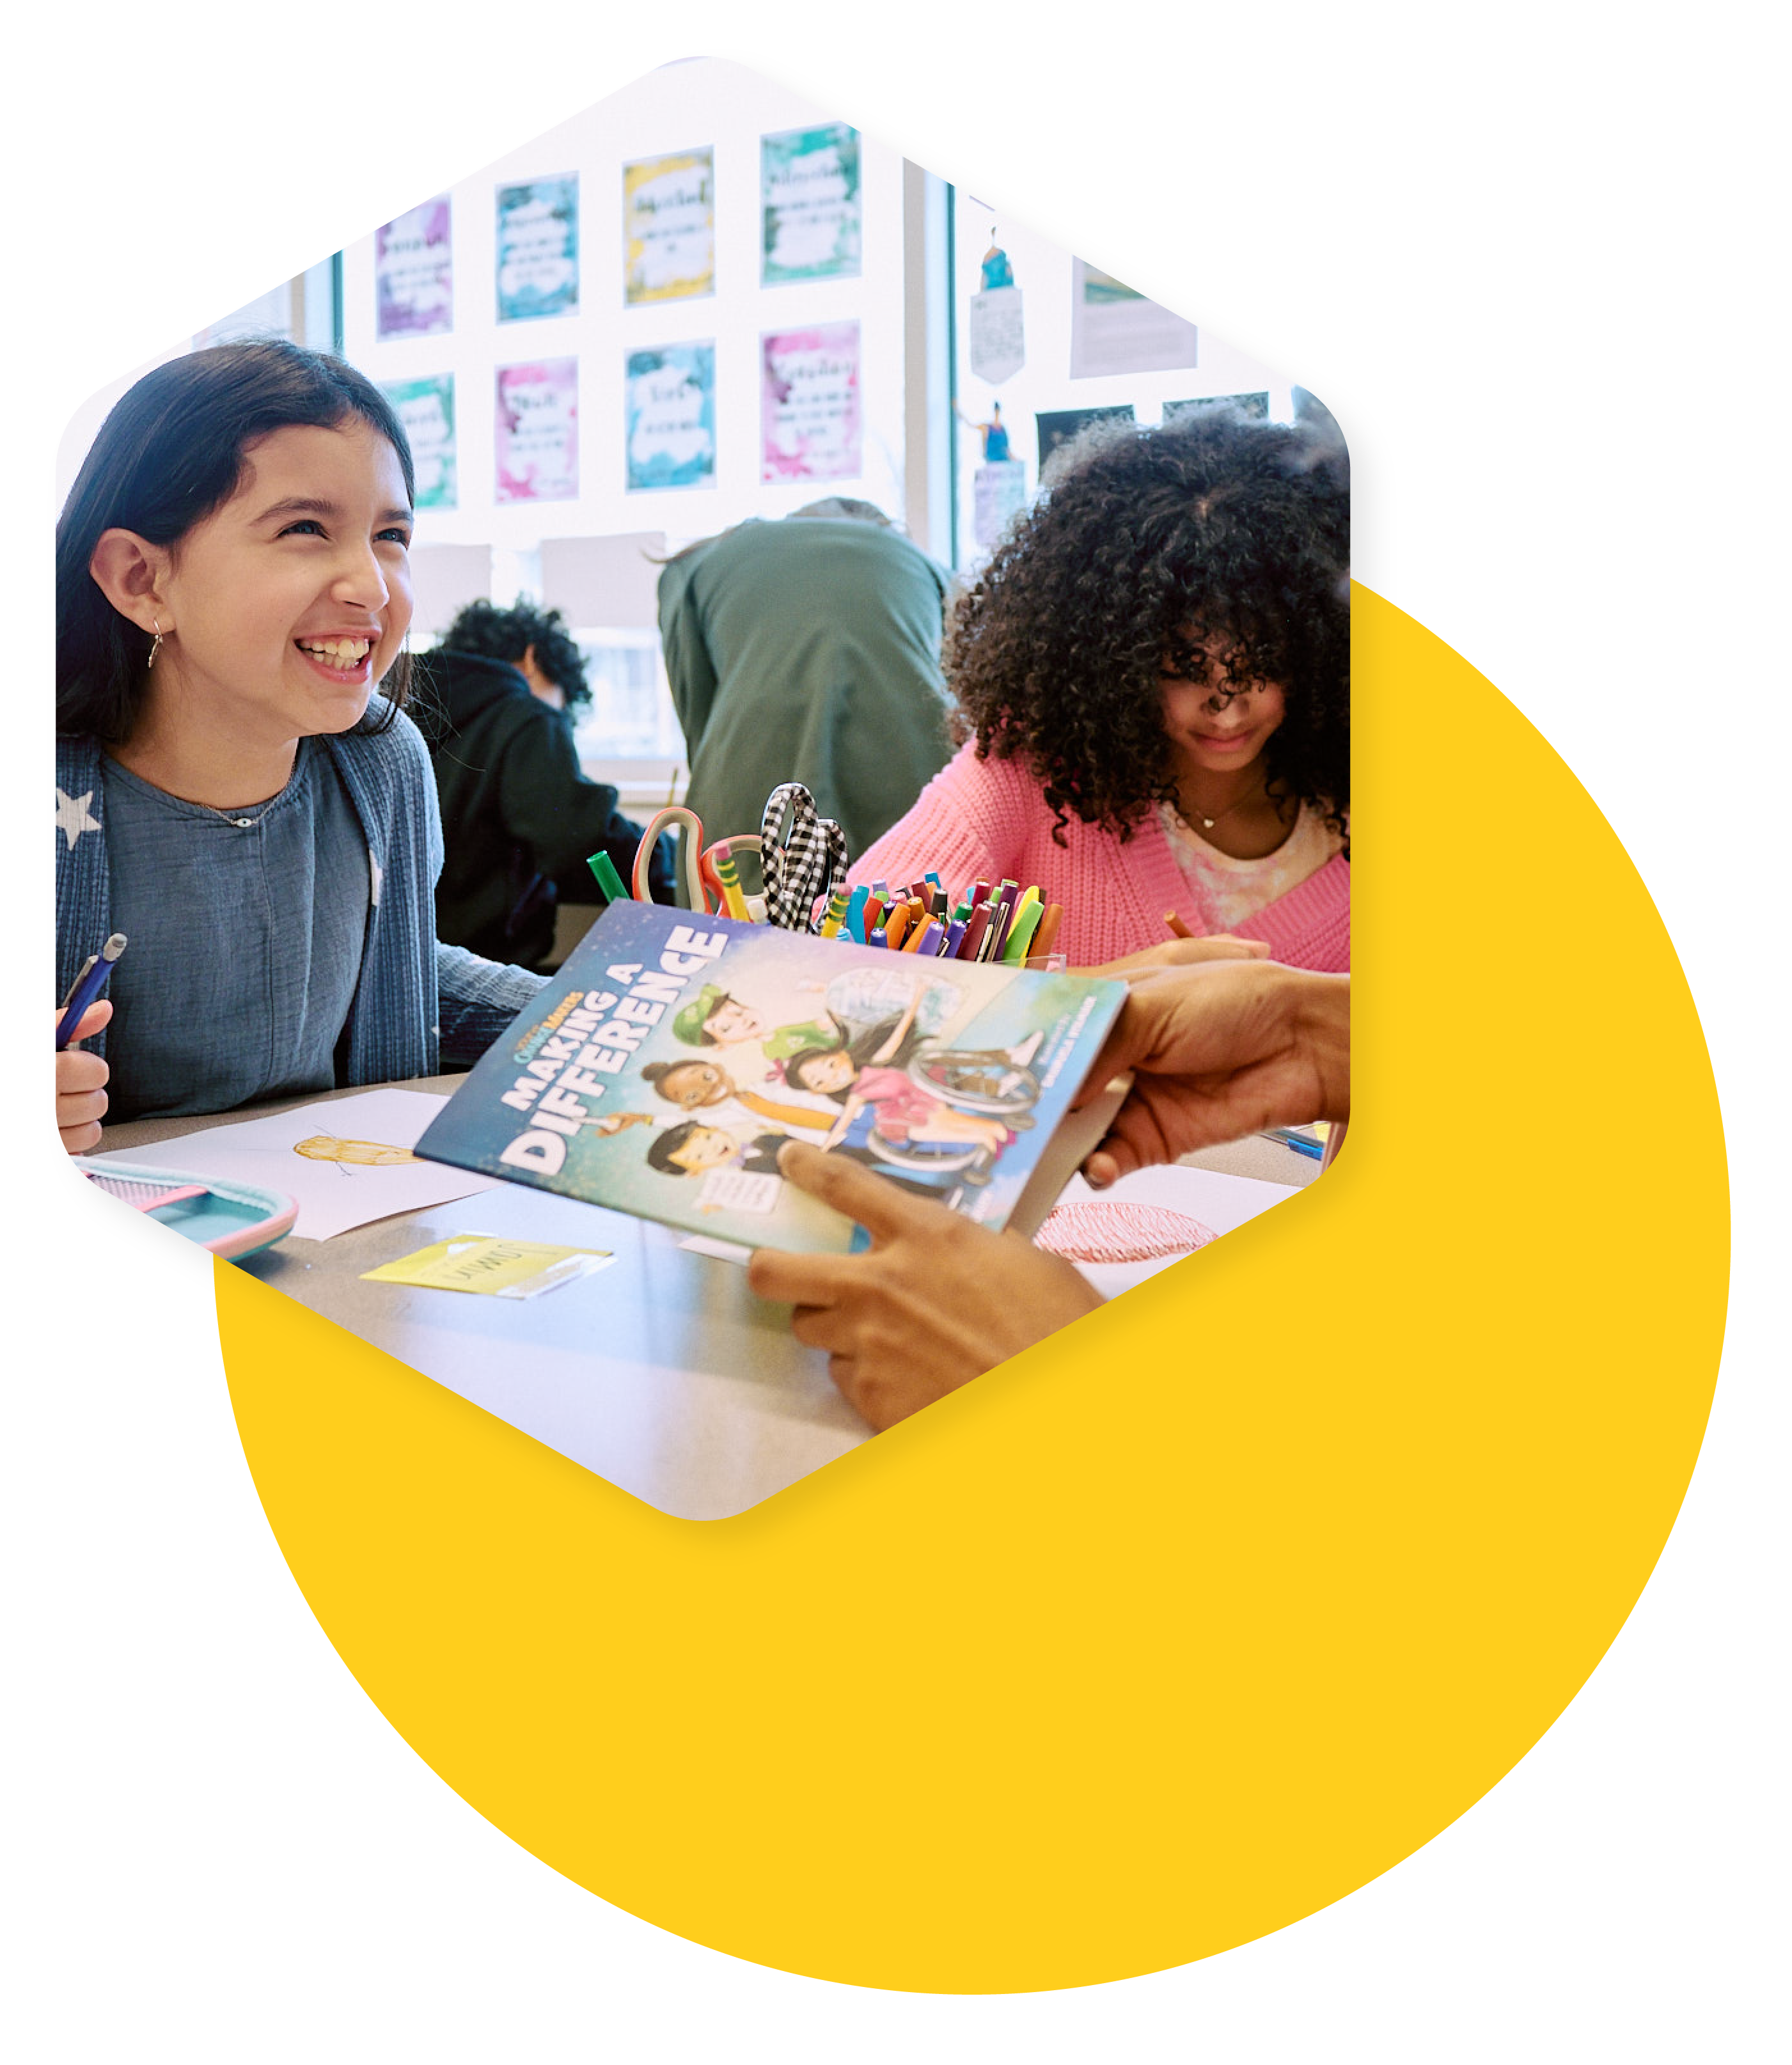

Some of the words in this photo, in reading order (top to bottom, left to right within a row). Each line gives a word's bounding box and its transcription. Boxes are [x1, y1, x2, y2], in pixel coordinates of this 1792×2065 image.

[499, 925, 729, 1175] DIFFERENCE
[501, 990, 618, 1111] MAKING
[606, 963, 644, 985] A
